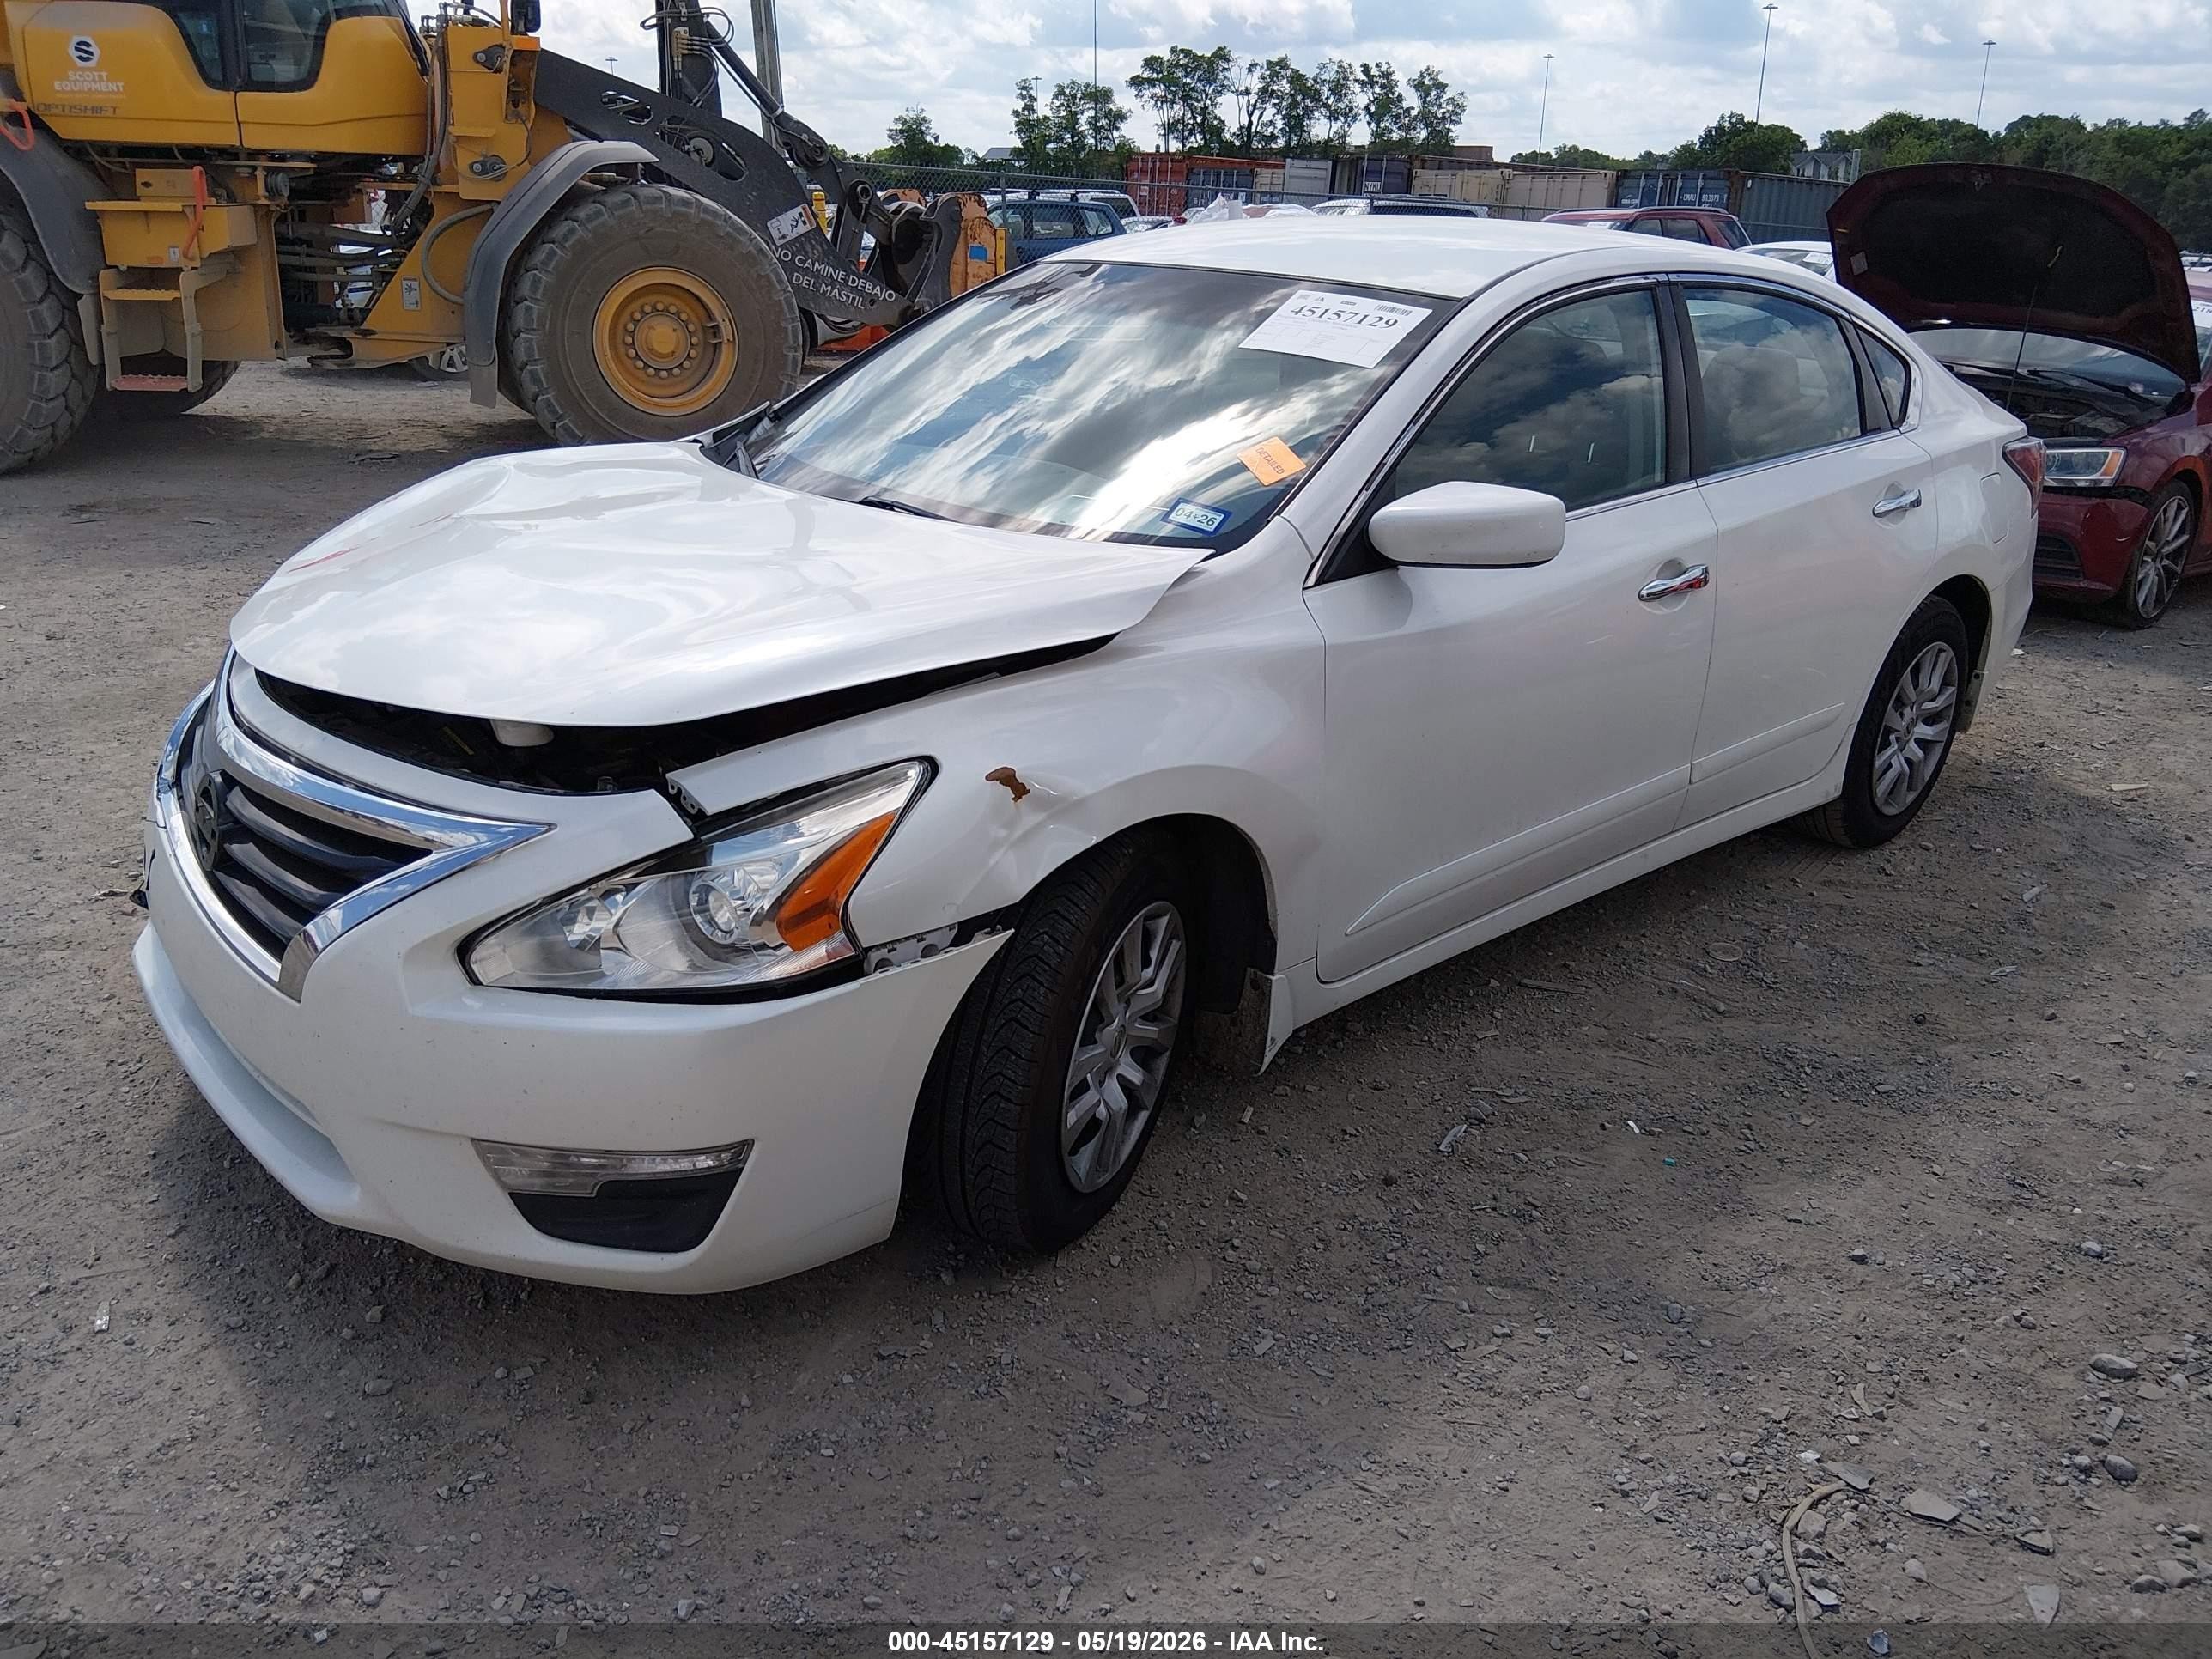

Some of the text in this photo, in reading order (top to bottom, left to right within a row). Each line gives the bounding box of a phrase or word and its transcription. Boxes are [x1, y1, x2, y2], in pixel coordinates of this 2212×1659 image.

[68, 71, 108, 82] SCOTT
[54, 82, 124, 92] EQUIPMENT
[35, 102, 118, 115] OPTISHIFT
[1364, 181, 1382, 192] NYKU
[795, 255, 848, 283] CAMINE
[848, 275, 896, 301] DEBAJO
[793, 272, 866, 309] DEL MÁSTIL
[1291, 304, 1399, 329] 45157129
[1255, 447, 1285, 475] DETAILED
